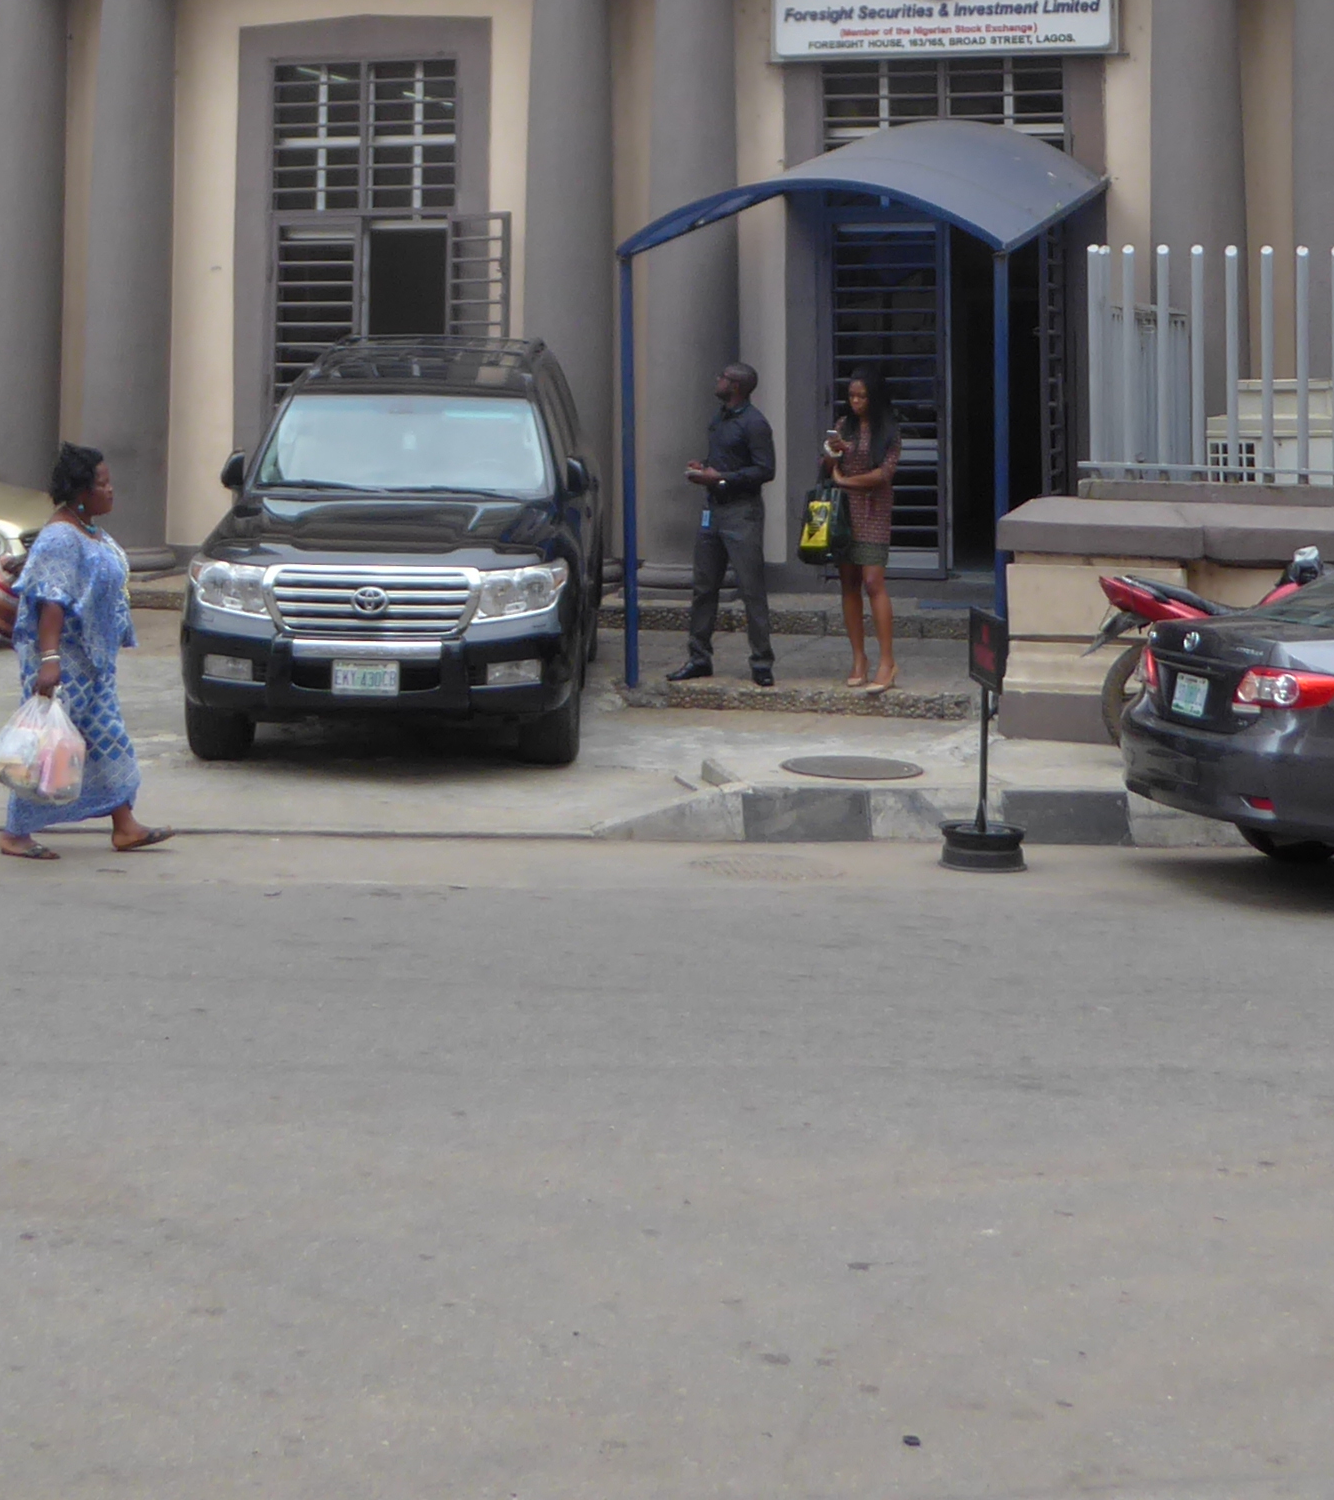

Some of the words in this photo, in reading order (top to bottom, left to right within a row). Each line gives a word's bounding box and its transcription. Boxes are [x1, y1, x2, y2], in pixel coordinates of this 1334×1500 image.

[783, 7, 854, 23] Foresight
[858, 4, 934, 20] Securities
[938, 3, 949, 17] &
[954, 0, 1039, 17] Investment
[840, 27, 880, 38] (Member
[883, 27, 893, 36] of
[895, 26, 910, 36] the
[913, 25, 952, 37] Nigerian
[955, 24, 982, 34] Stock
[985, 22, 1038, 35] Exchange)
[808, 40, 864, 50] FORESIGHT
[868, 38, 905, 49] HOUSE,
[949, 36, 986, 46] BROAD
[990, 35, 1033, 45] STREET,
[1036, 34, 1076, 44] LAGOS.
